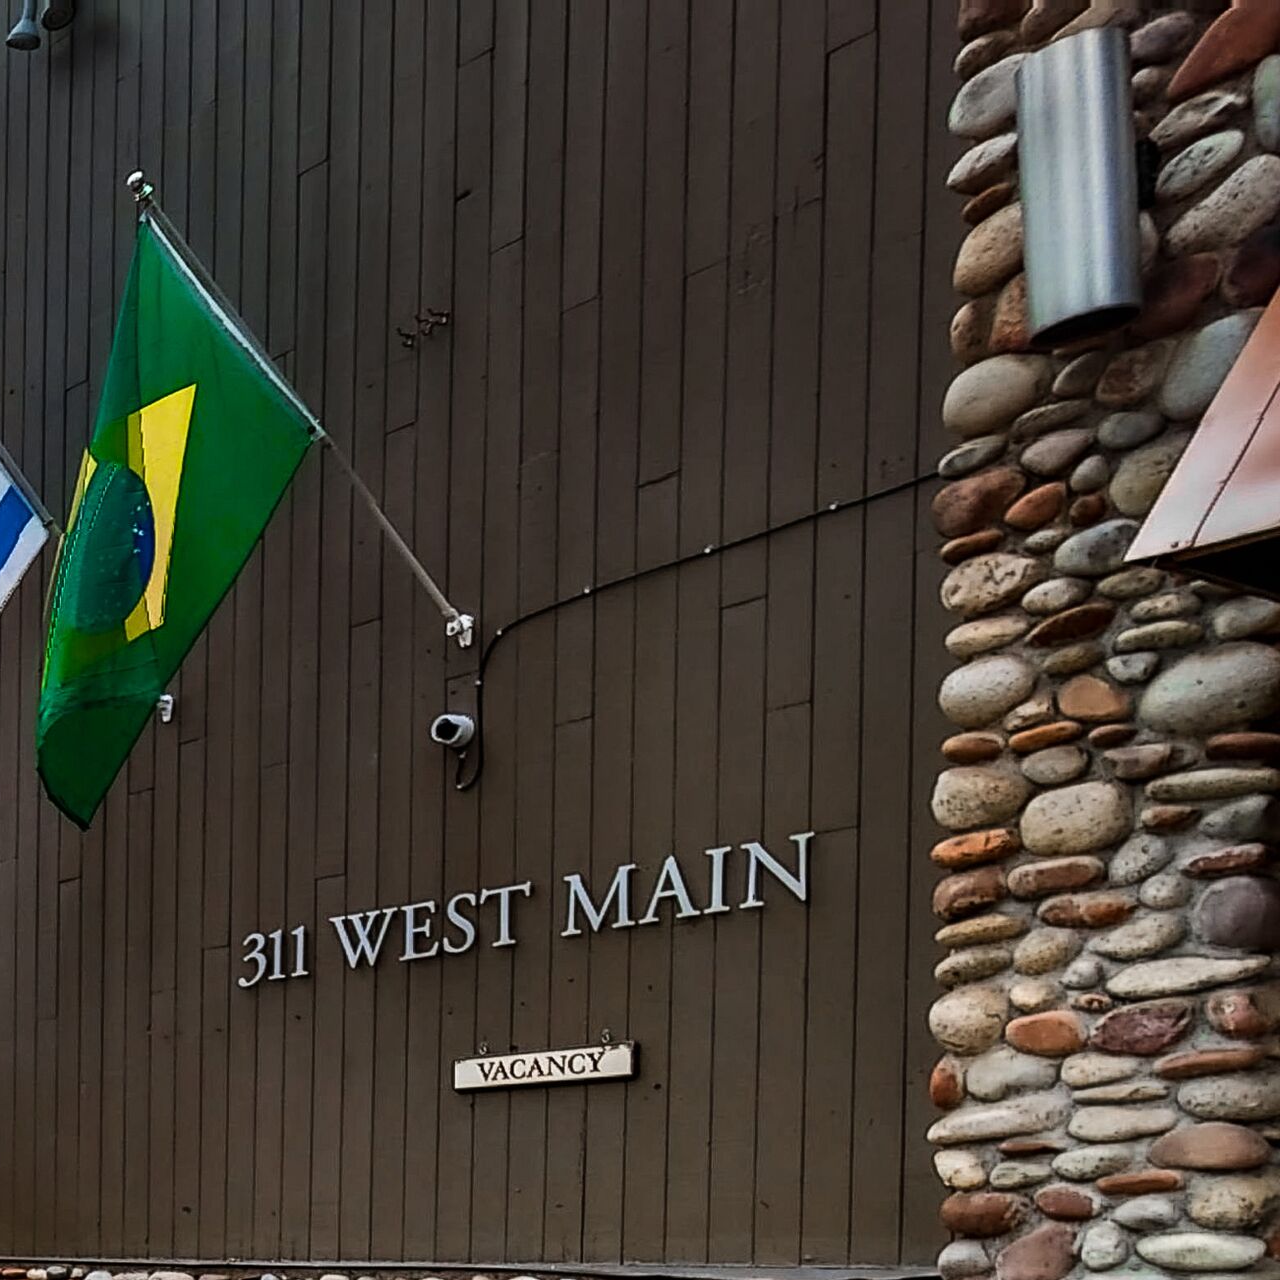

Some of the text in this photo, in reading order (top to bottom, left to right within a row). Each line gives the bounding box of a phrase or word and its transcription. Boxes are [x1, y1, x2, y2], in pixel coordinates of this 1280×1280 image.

[238, 831, 816, 988] 311 WEST MAIN
[476, 1050, 606, 1083] VACANCY
